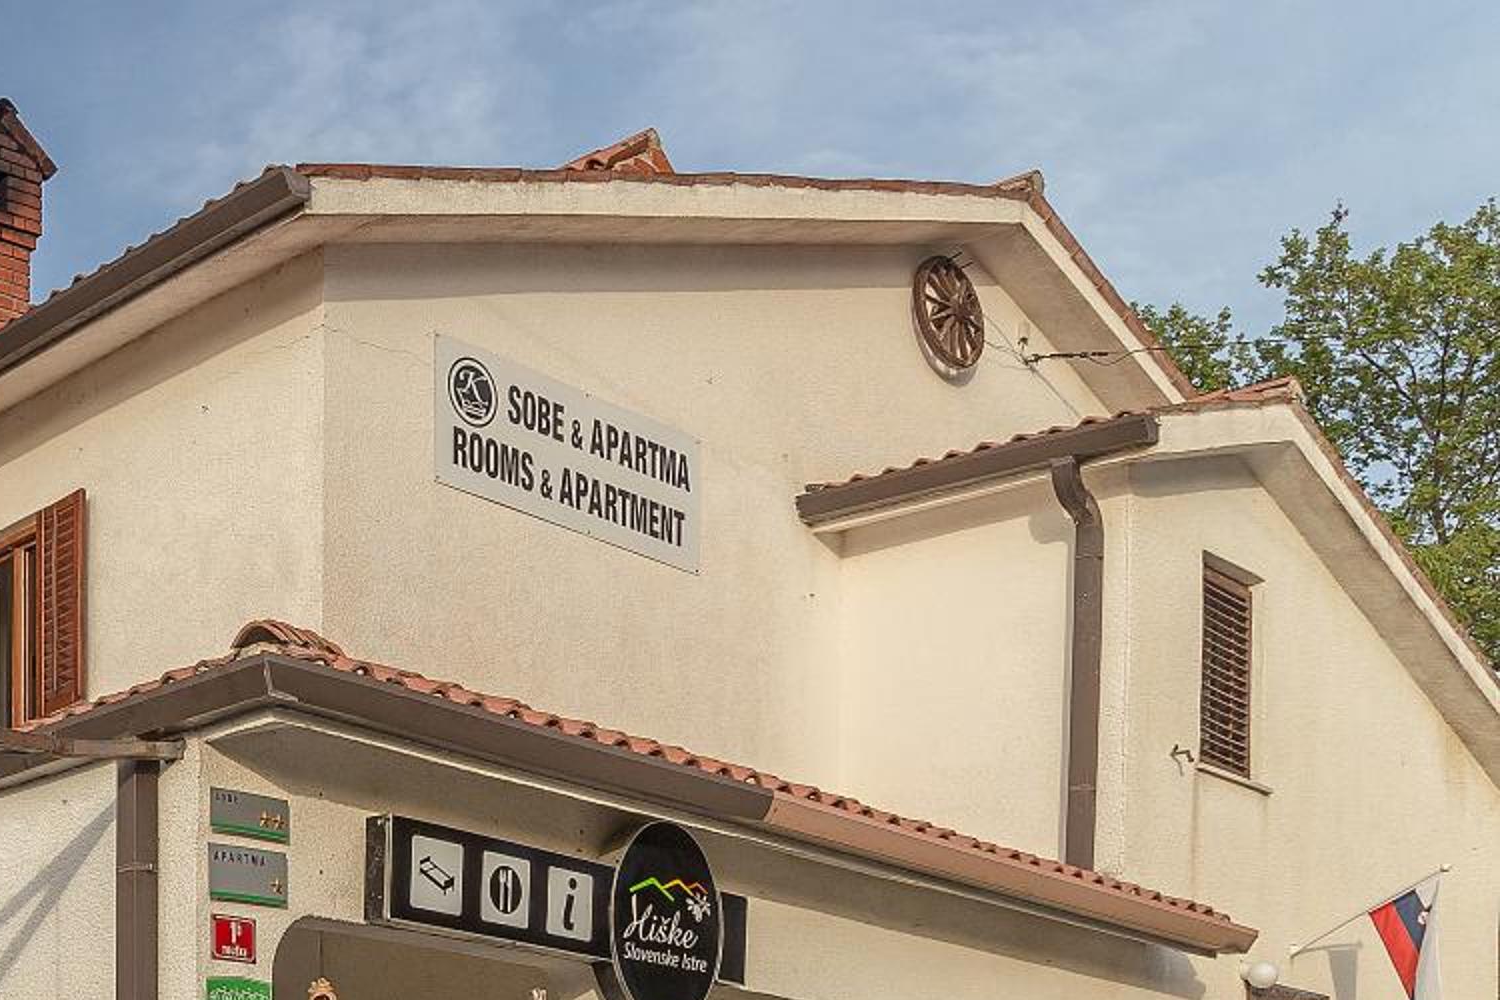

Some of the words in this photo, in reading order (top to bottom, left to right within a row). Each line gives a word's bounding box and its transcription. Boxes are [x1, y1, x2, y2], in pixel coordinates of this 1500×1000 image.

[507, 385, 565, 443] SOBE
[571, 419, 584, 451] &
[590, 418, 691, 492] APARTMA
[453, 426, 534, 492] ROOMS
[540, 469, 553, 501] &
[559, 466, 685, 547] APARTMENT
[622, 893, 699, 949] Hiške
[623, 941, 680, 968] Slovenske
[681, 952, 708, 974] Istre
